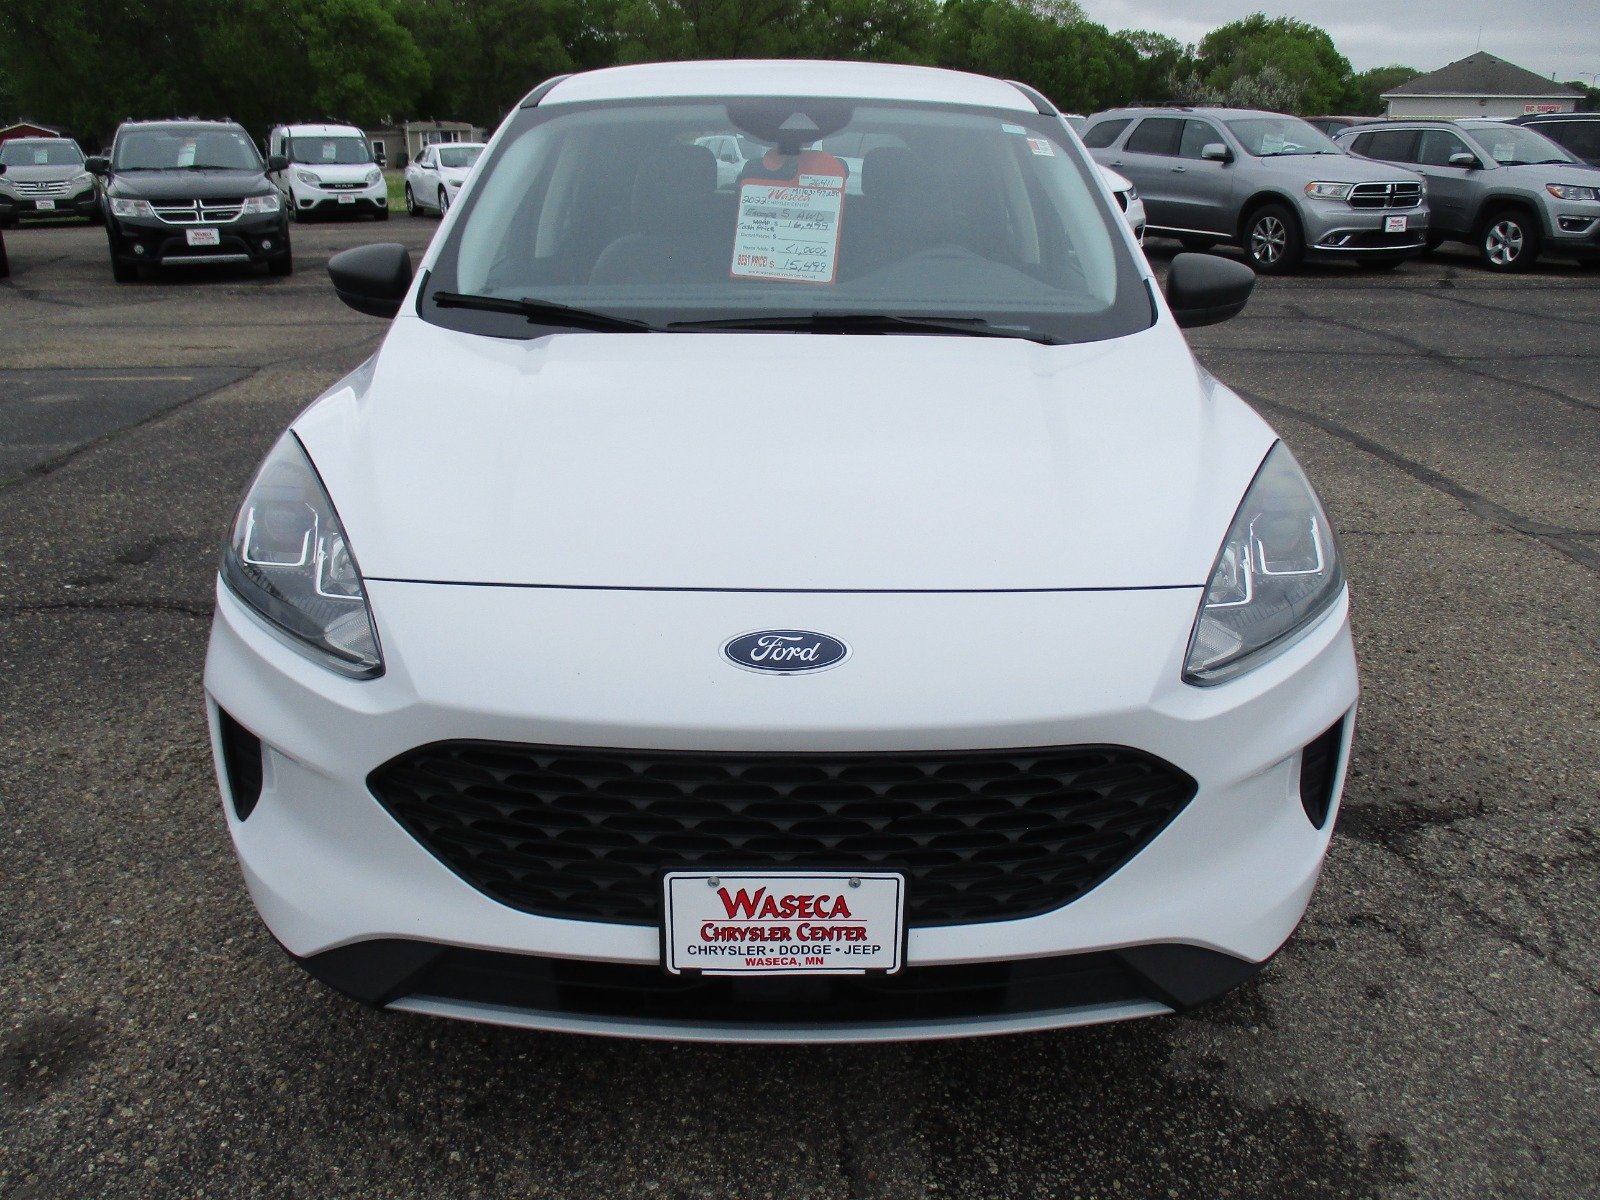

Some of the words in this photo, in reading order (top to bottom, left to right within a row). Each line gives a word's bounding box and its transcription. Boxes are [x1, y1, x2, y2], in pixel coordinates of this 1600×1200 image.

[781, 208, 790, 218] S
[796, 211, 825, 222] AWD
[750, 635, 821, 661] Ford
[717, 886, 852, 919] WASECA
[700, 922, 792, 942] CHRYSLER
[796, 922, 868, 942] CENTER
[687, 945, 766, 956] CHRYSLER
[779, 944, 832, 956] DODGE
[844, 944, 881, 955] JEEP
[745, 957, 802, 967] WASECA,
[805, 956, 824, 965] MN
